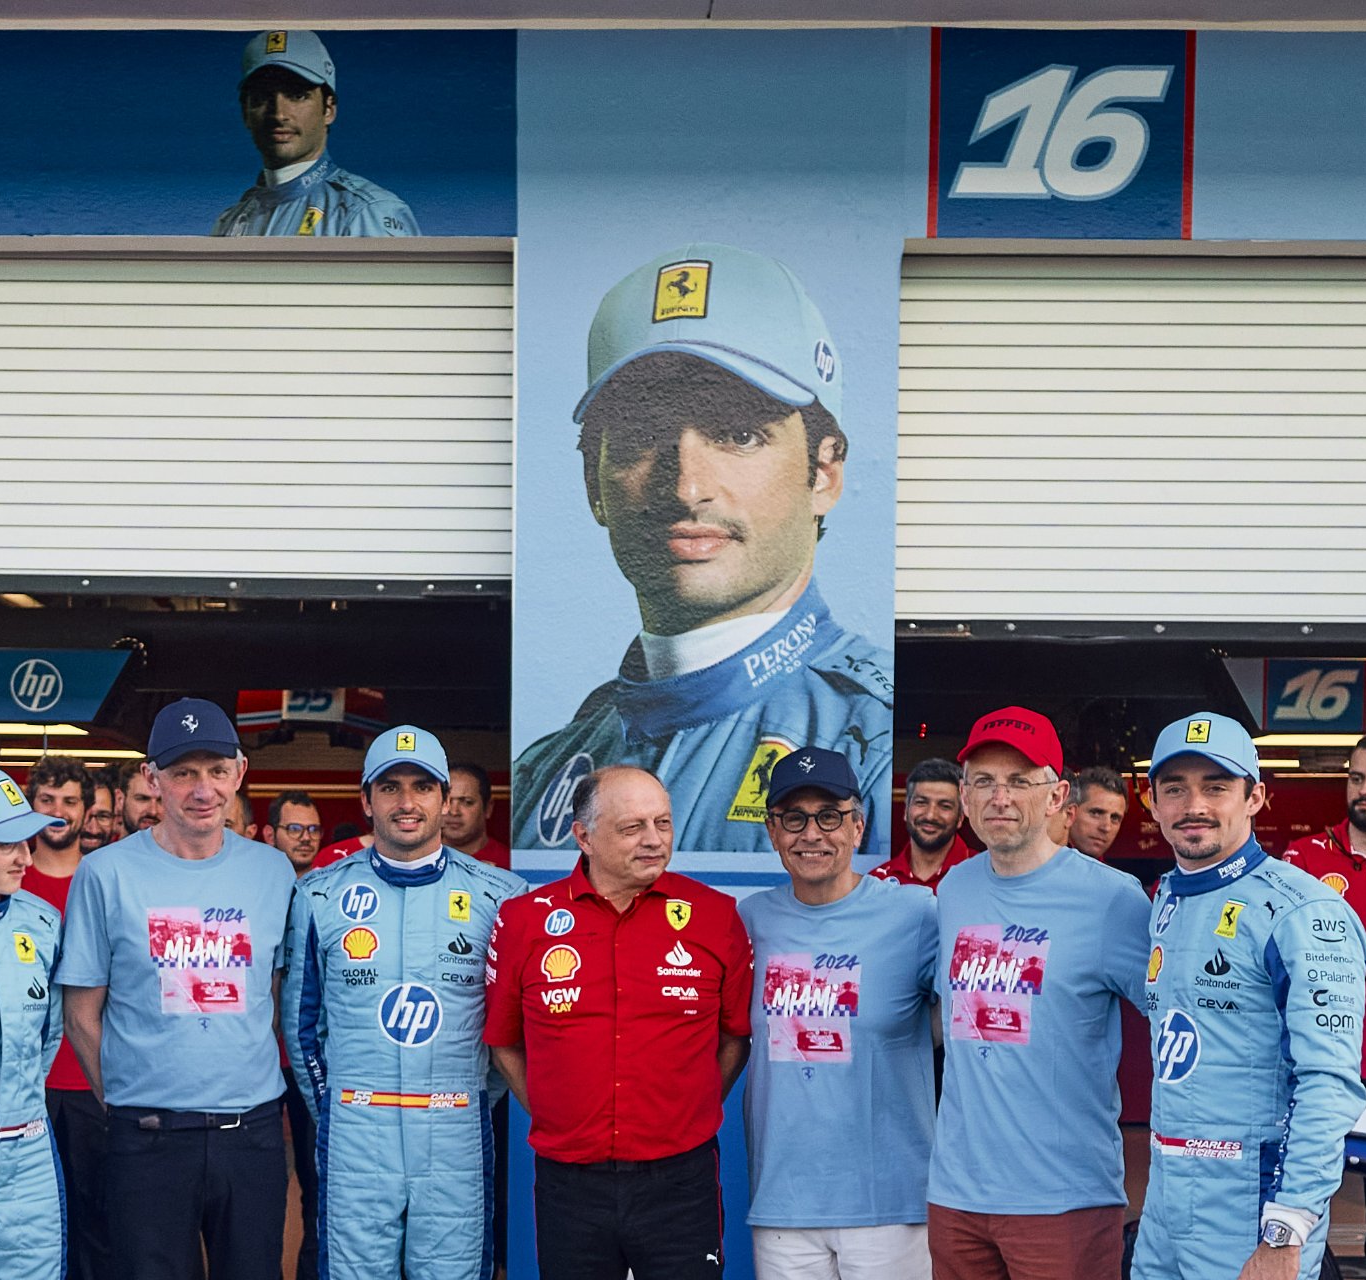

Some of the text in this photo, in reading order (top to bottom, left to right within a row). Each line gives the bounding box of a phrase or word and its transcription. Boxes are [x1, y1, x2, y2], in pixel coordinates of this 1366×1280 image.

[948, 63, 1175, 203] 16
[743, 612, 817, 681] PERONI
[13, 659, 60, 713] hp
[1272, 668, 1360, 722] 16
[1217, 855, 1247, 877] PERONI
[344, 884, 375, 921] hp
[203, 907, 247, 924] 2024
[548, 909, 572, 936] hp
[1002, 923, 1050, 945] 2024
[1311, 918, 1347, 935] aws
[437, 953, 480, 966] Santander
[813, 952, 862, 970] 2024
[341, 968, 379, 979] GLOBAL
[656, 966, 702, 978] Santander
[1320, 969, 1357, 985] Palantir
[344, 977, 377, 987] POKER
[1194, 975, 1242, 991] Santander
[540, 986, 582, 1006] VGW
[383, 983, 438, 1047] hp
[549, 1002, 573, 1014] PLAY
[1315, 1013, 1355, 1032] apm
[350, 1090, 373, 1106] 55
[430, 1092, 469, 1101] CARLOS
[1185, 1139, 1241, 1151] CHARLES
[1183, 1149, 1237, 1159] LECLERC
